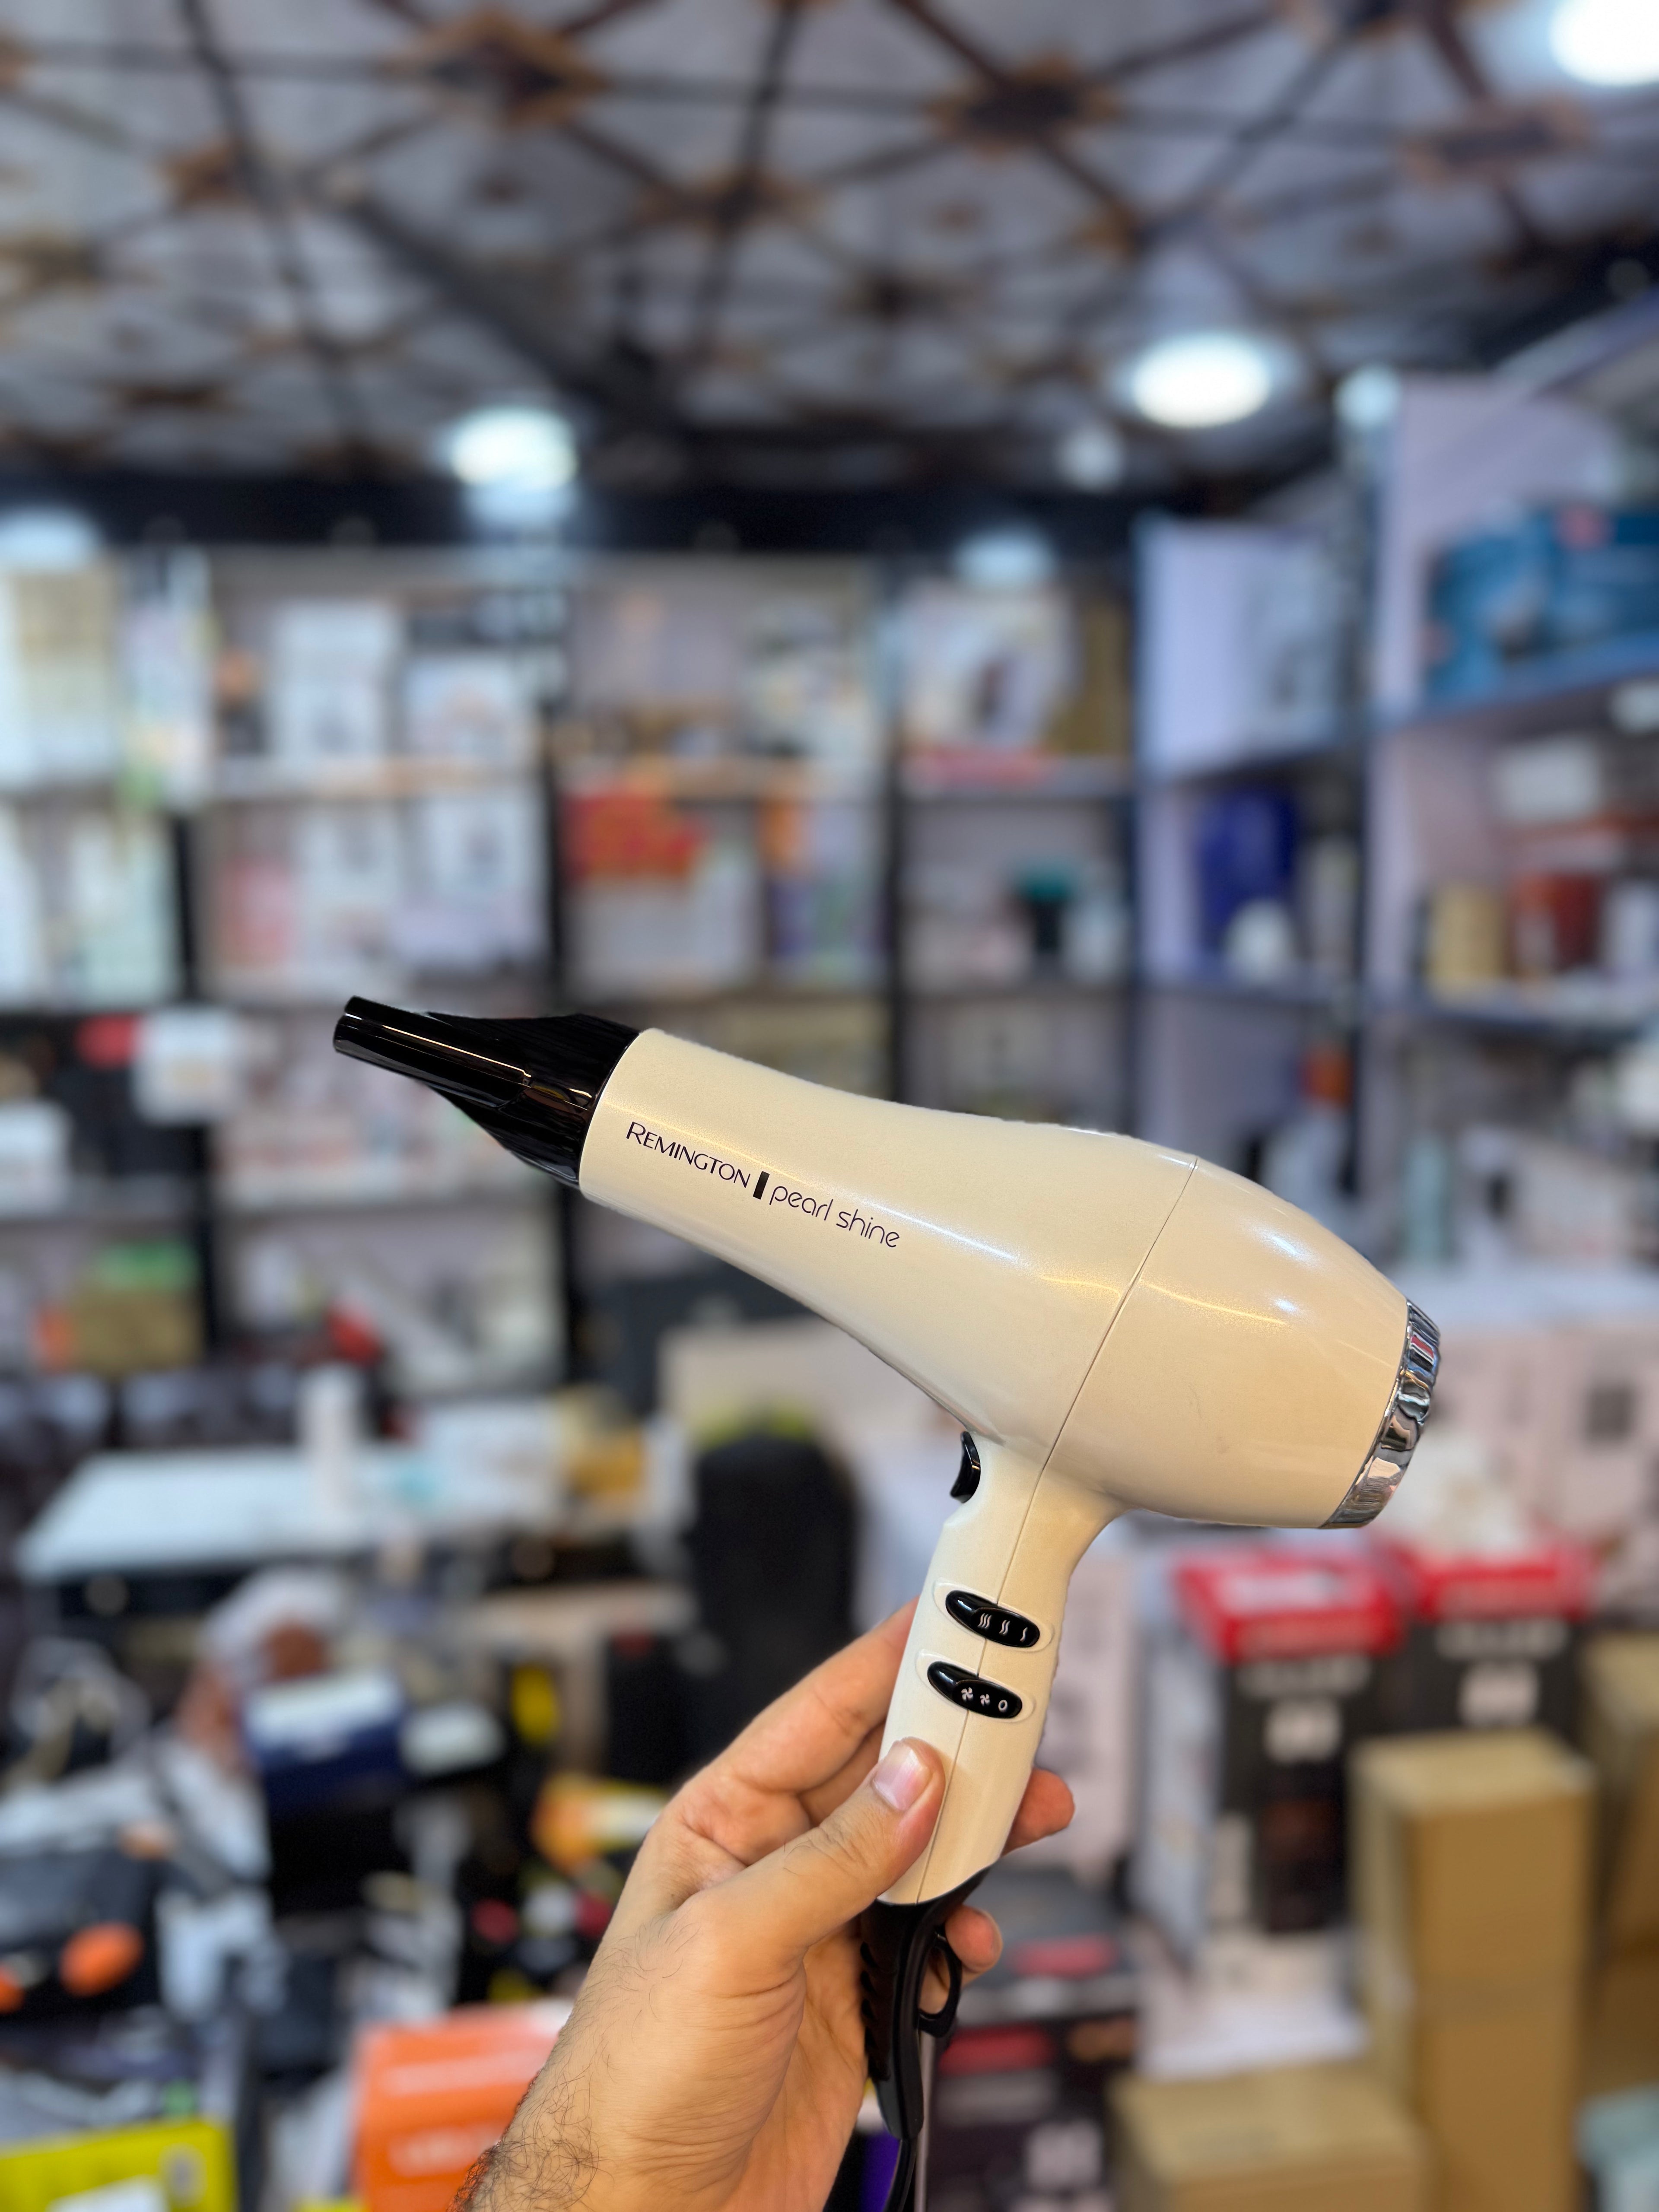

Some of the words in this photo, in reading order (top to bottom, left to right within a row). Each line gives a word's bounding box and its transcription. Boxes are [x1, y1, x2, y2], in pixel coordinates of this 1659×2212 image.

[626, 1121, 751, 1188] REMINGTON
[769, 1185, 834, 1220] pearl
[836, 1209, 900, 1248] shine
